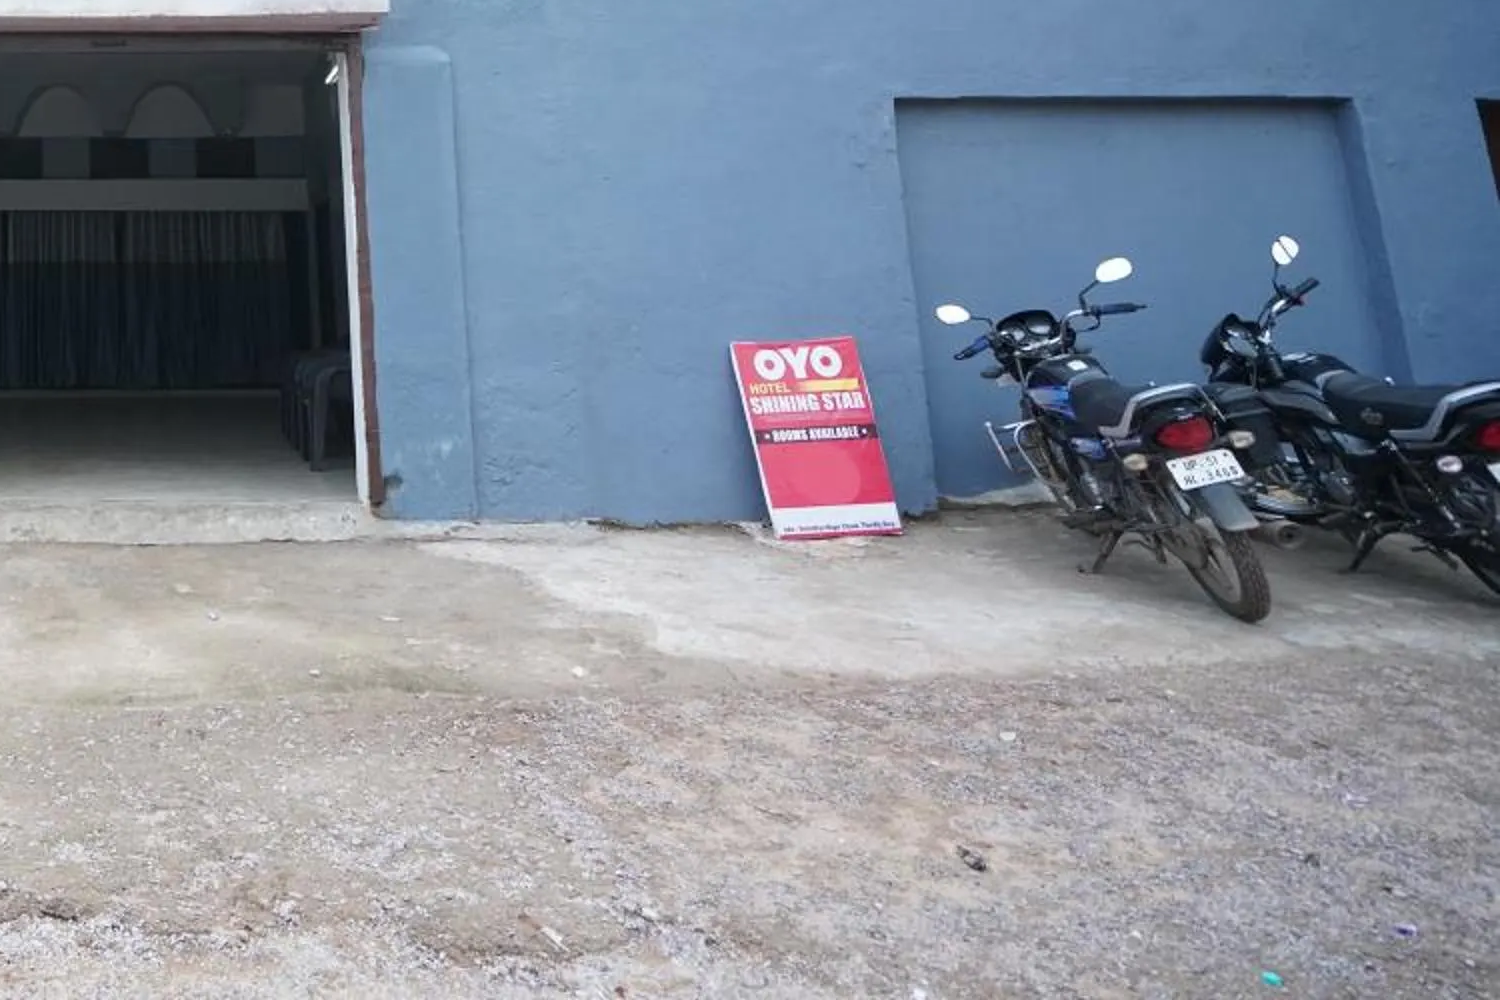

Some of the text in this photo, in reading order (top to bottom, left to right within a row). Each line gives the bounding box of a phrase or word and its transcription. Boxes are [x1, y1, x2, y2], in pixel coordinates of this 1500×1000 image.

[753, 345, 843, 381] OYO
[749, 382, 791, 394] HOTEL
[749, 391, 866, 415] SHINING STAR
[771, 426, 860, 442] ROOMS AVAILABLE
